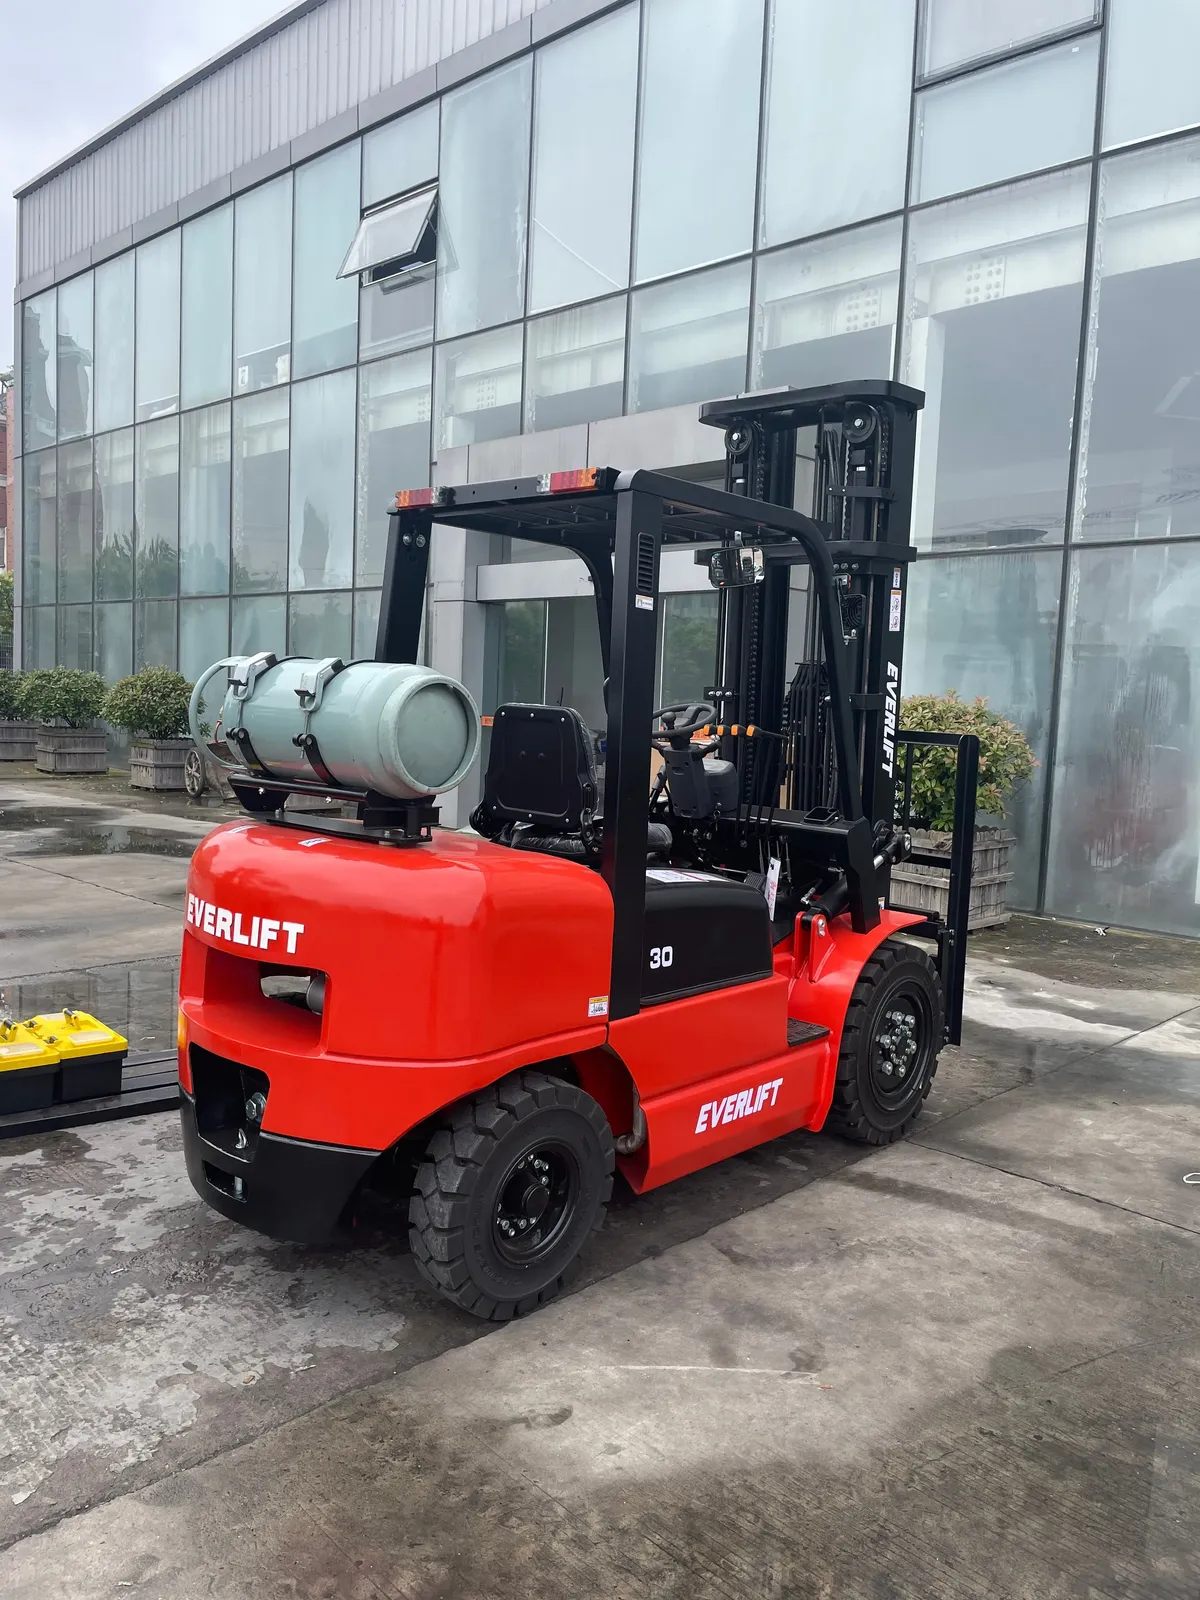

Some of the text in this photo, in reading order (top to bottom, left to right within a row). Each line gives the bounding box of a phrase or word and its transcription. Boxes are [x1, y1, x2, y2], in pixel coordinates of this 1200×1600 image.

[881, 661, 900, 779] EVERLIFT
[187, 893, 305, 954] EVERLIFT
[649, 945, 673, 969] 30
[695, 1077, 784, 1134] EVERLIFT
